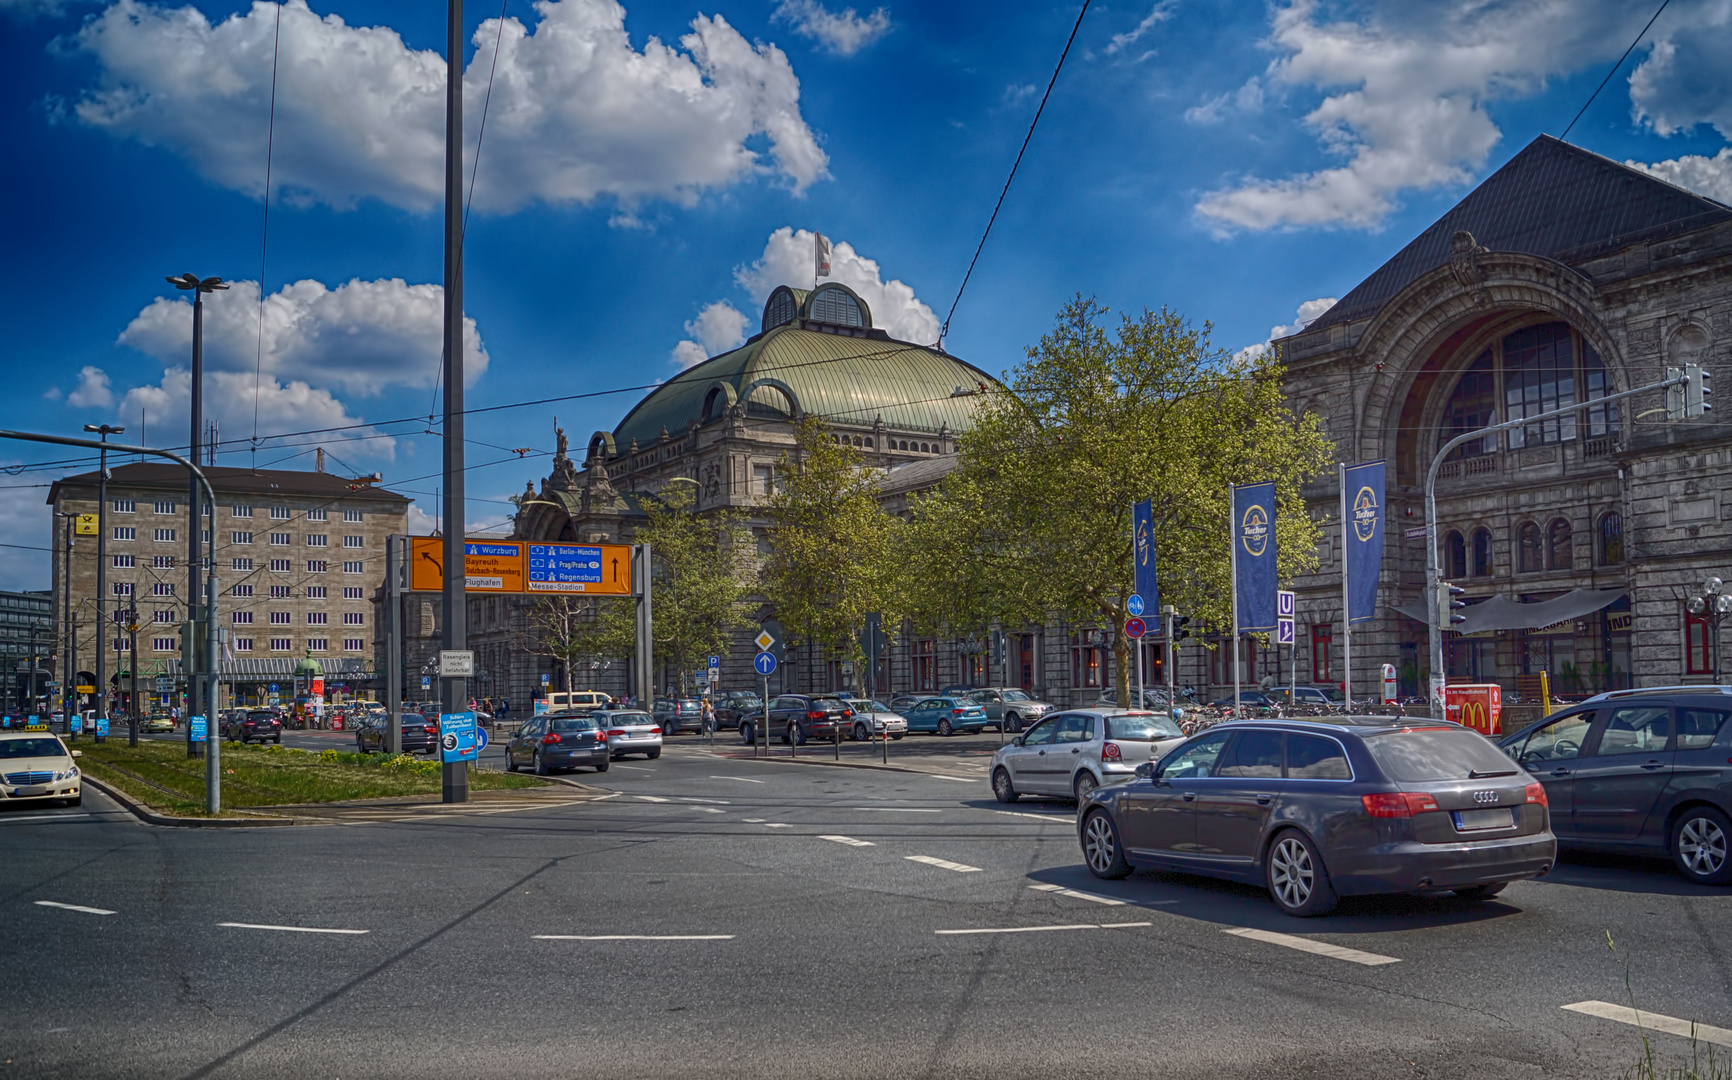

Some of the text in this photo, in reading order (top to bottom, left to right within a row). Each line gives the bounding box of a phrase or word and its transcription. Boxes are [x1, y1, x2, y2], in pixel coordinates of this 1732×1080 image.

[1356, 510, 1375, 519] Tucher
[1244, 526, 1267, 535] Tucher
[482, 546, 517, 556] Würzburg
[559, 548, 600, 556] Berlin-München
[466, 557, 499, 566] Bayreuth
[559, 561, 587, 570] Prag/Praha
[466, 567, 521, 577] Sulzbach-Rosenberg
[559, 573, 600, 582] Regensburg
[465, 579, 501, 587] Flughafen
[531, 583, 583, 591] Messe-Stadion
[1282, 595, 1292, 613] U
[710, 657, 717, 667] P
